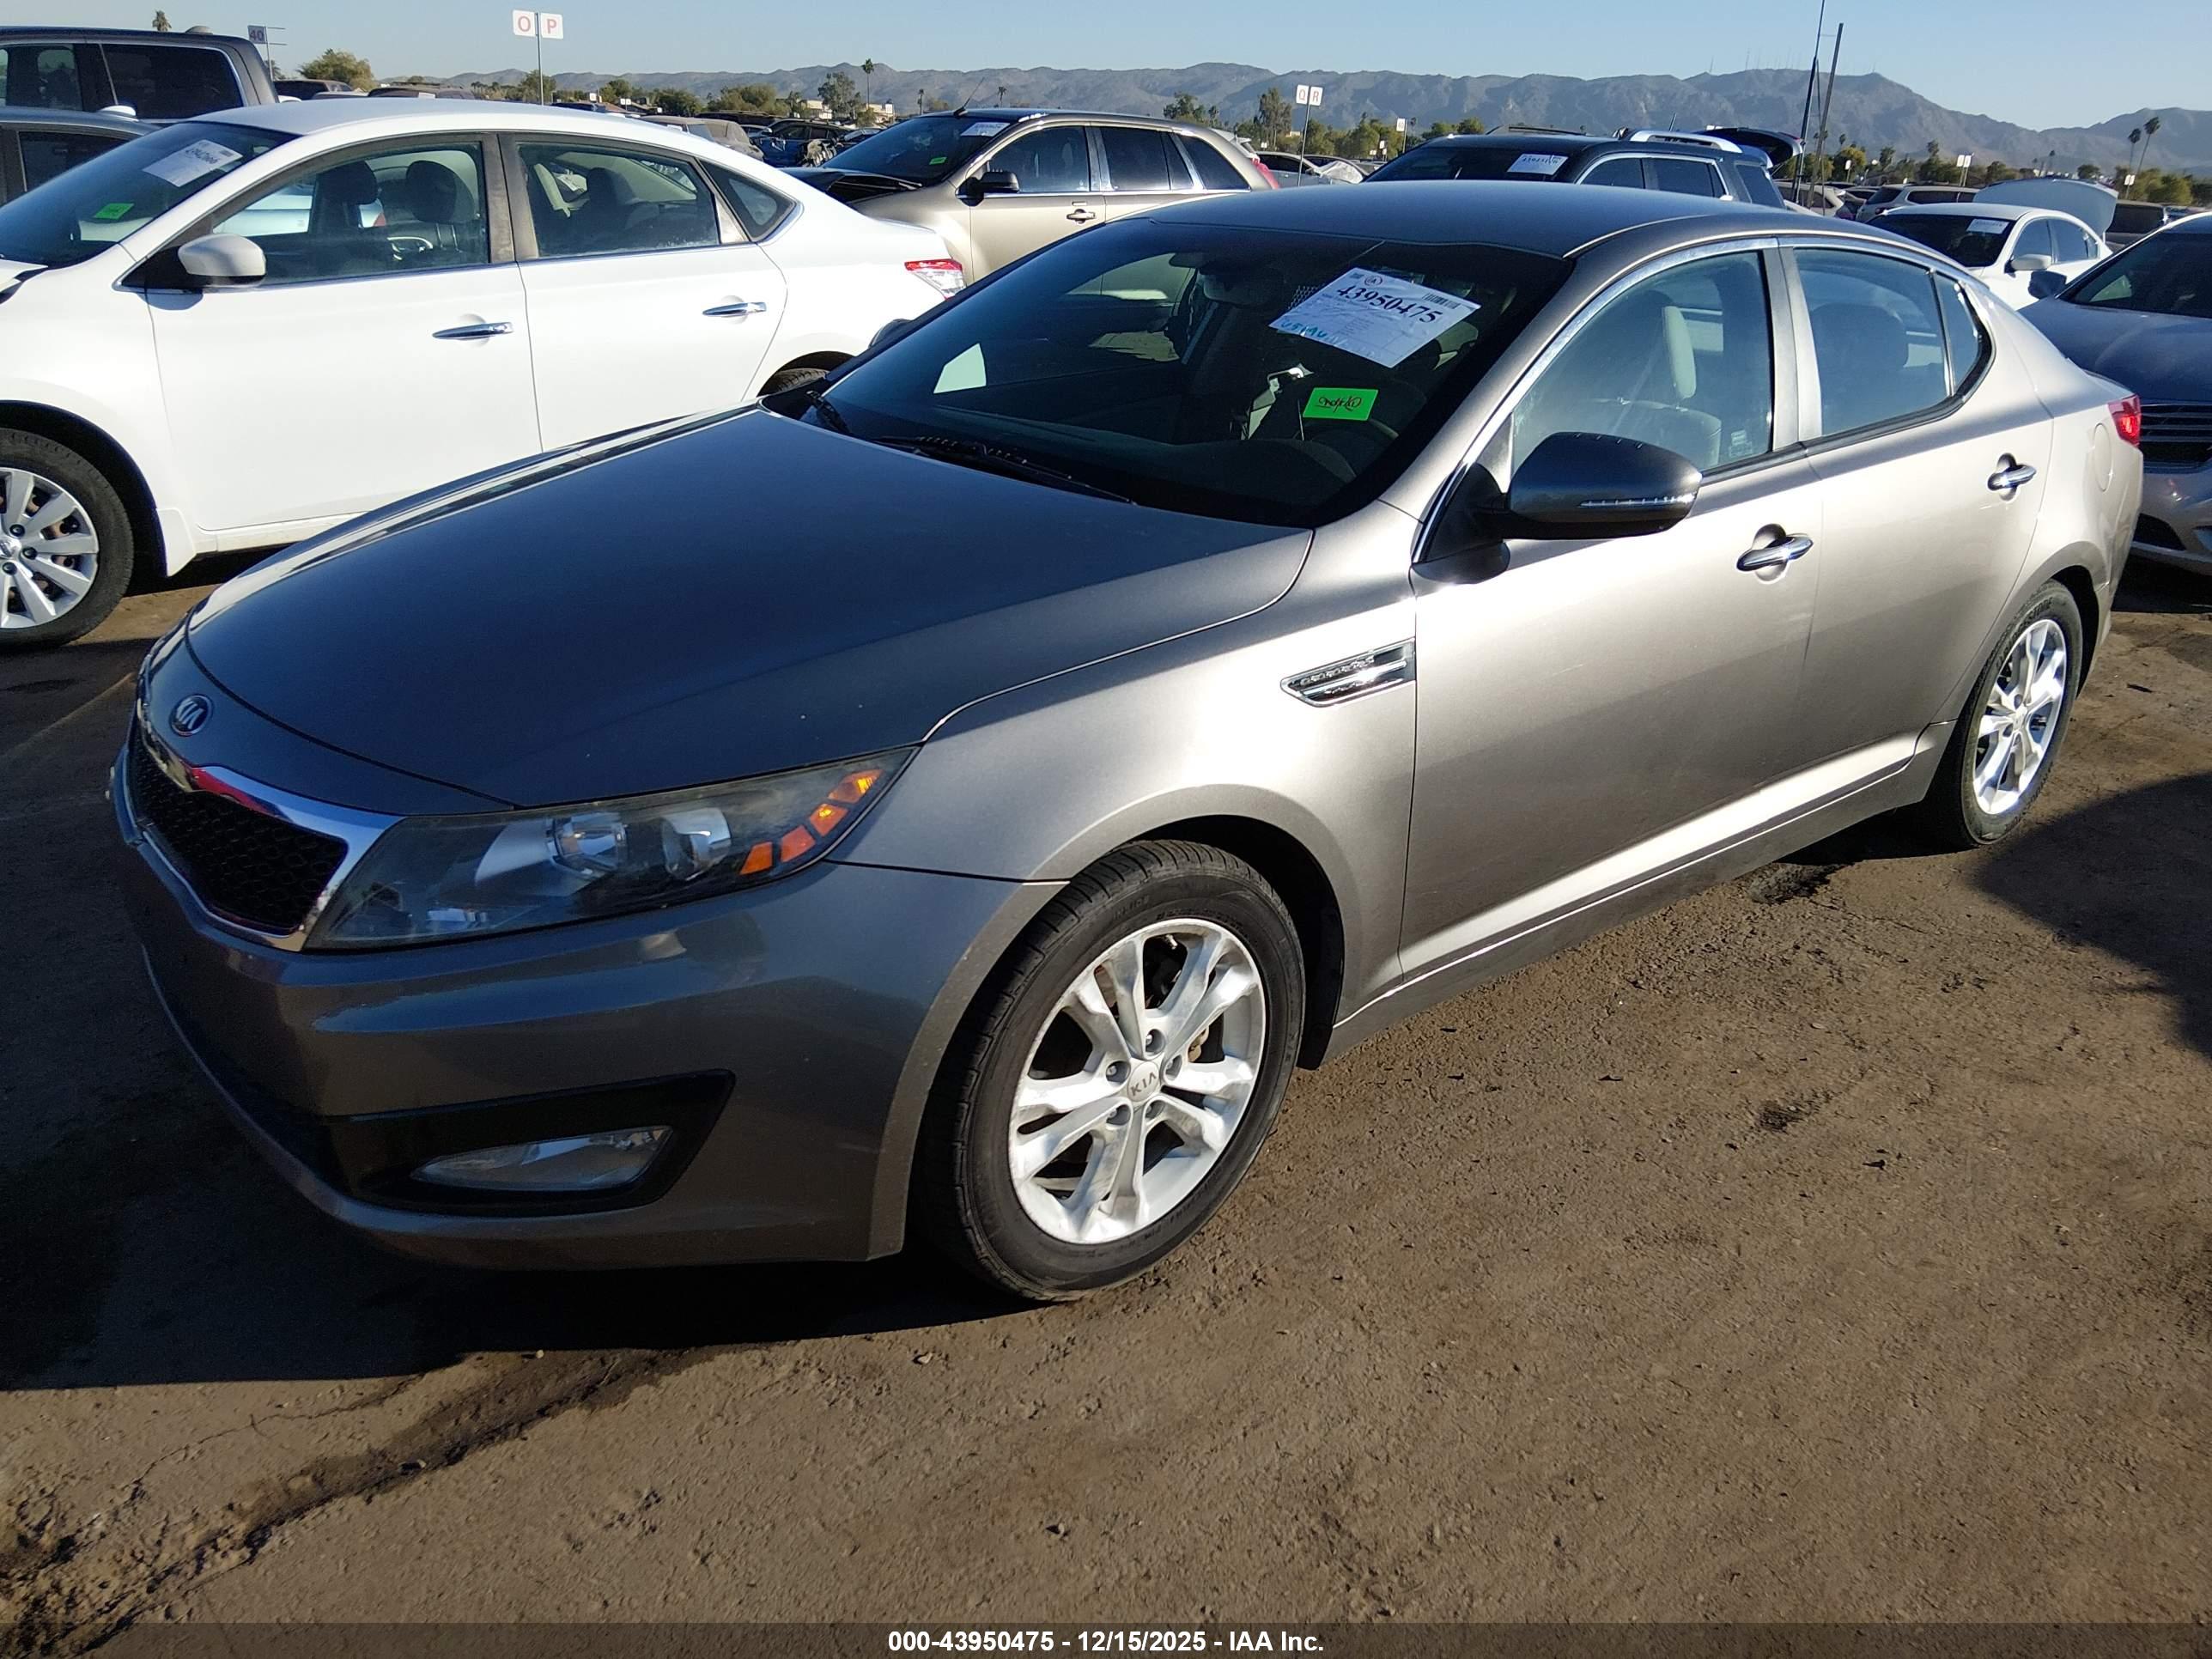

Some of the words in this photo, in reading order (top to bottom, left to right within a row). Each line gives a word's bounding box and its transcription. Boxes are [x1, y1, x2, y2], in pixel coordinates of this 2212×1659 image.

[517, 15, 532, 33] O
[546, 18, 557, 34] P
[1298, 88, 1306, 101] Q
[1312, 90, 1320, 102] R
[1337, 285, 1443, 323] 43950475
[1130, 1072, 1157, 1097] KIA
